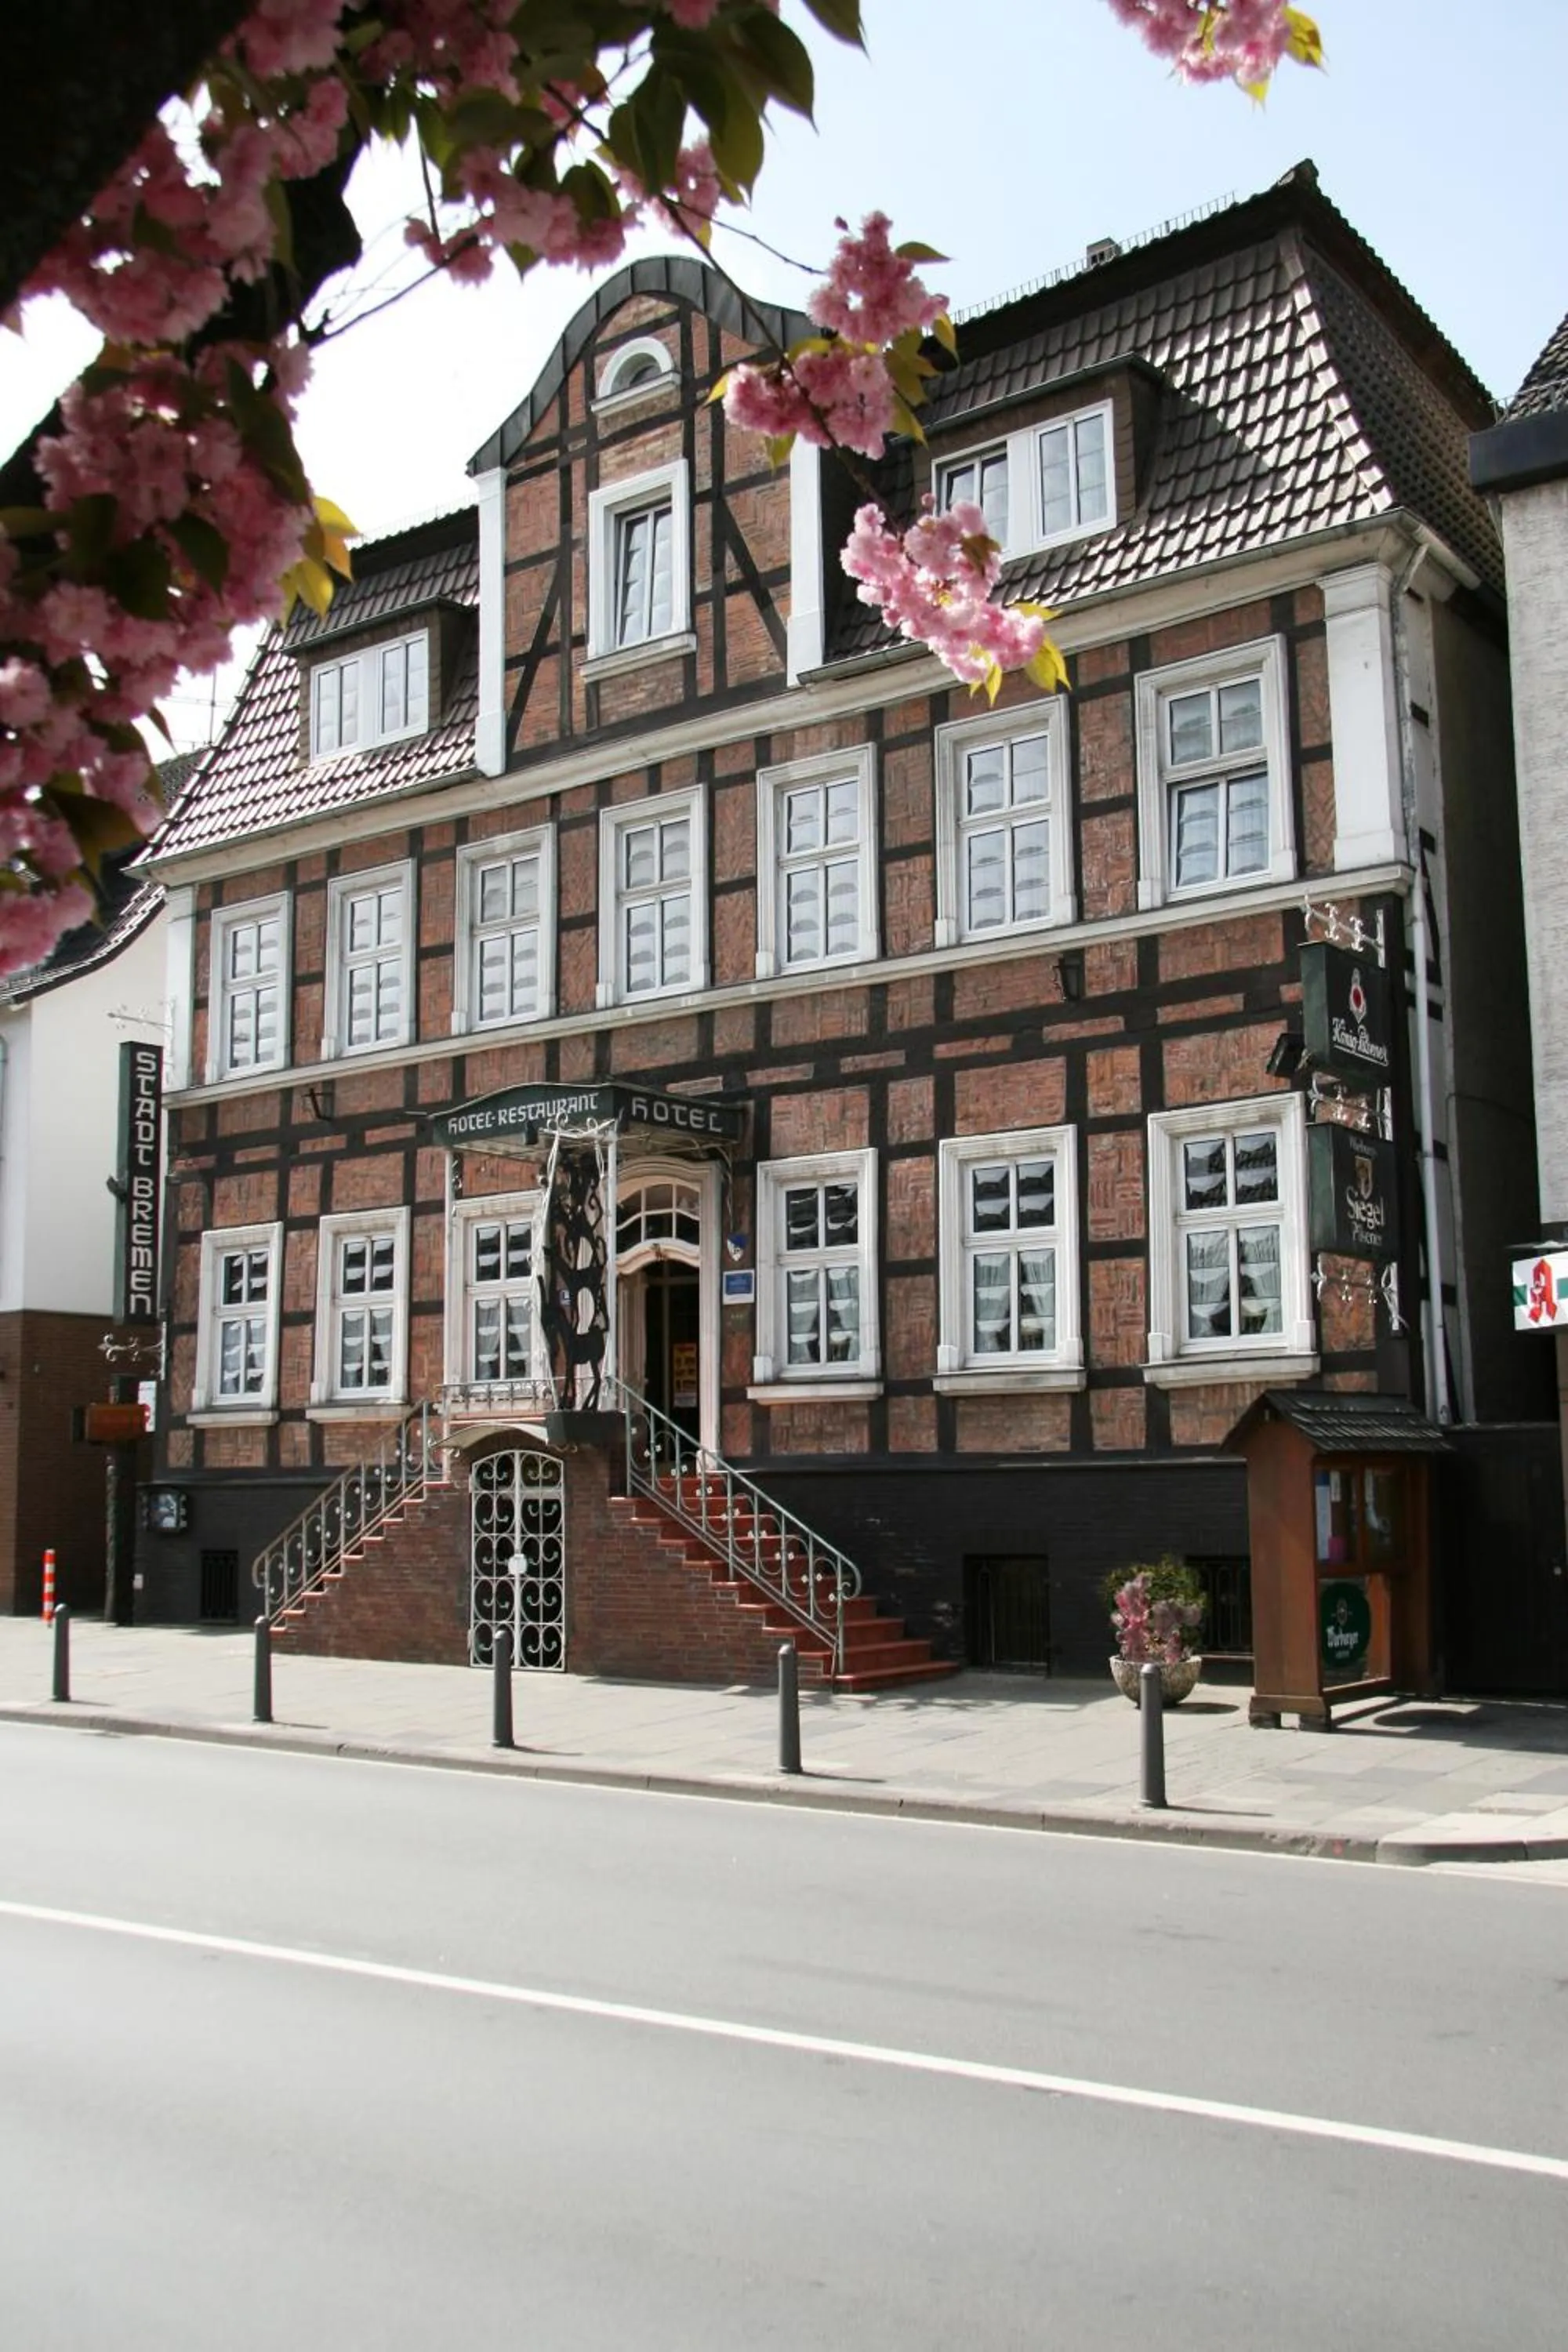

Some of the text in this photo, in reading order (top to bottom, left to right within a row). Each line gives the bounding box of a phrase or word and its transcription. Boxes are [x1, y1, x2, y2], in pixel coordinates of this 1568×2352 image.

[447, 1092, 600, 1135] HOTEL-RESTAURANT
[631, 1097, 722, 1133] HOTEL
[129, 1051, 157, 1315] STADT BREMEN
[1345, 1185, 1385, 1229] Siegel
